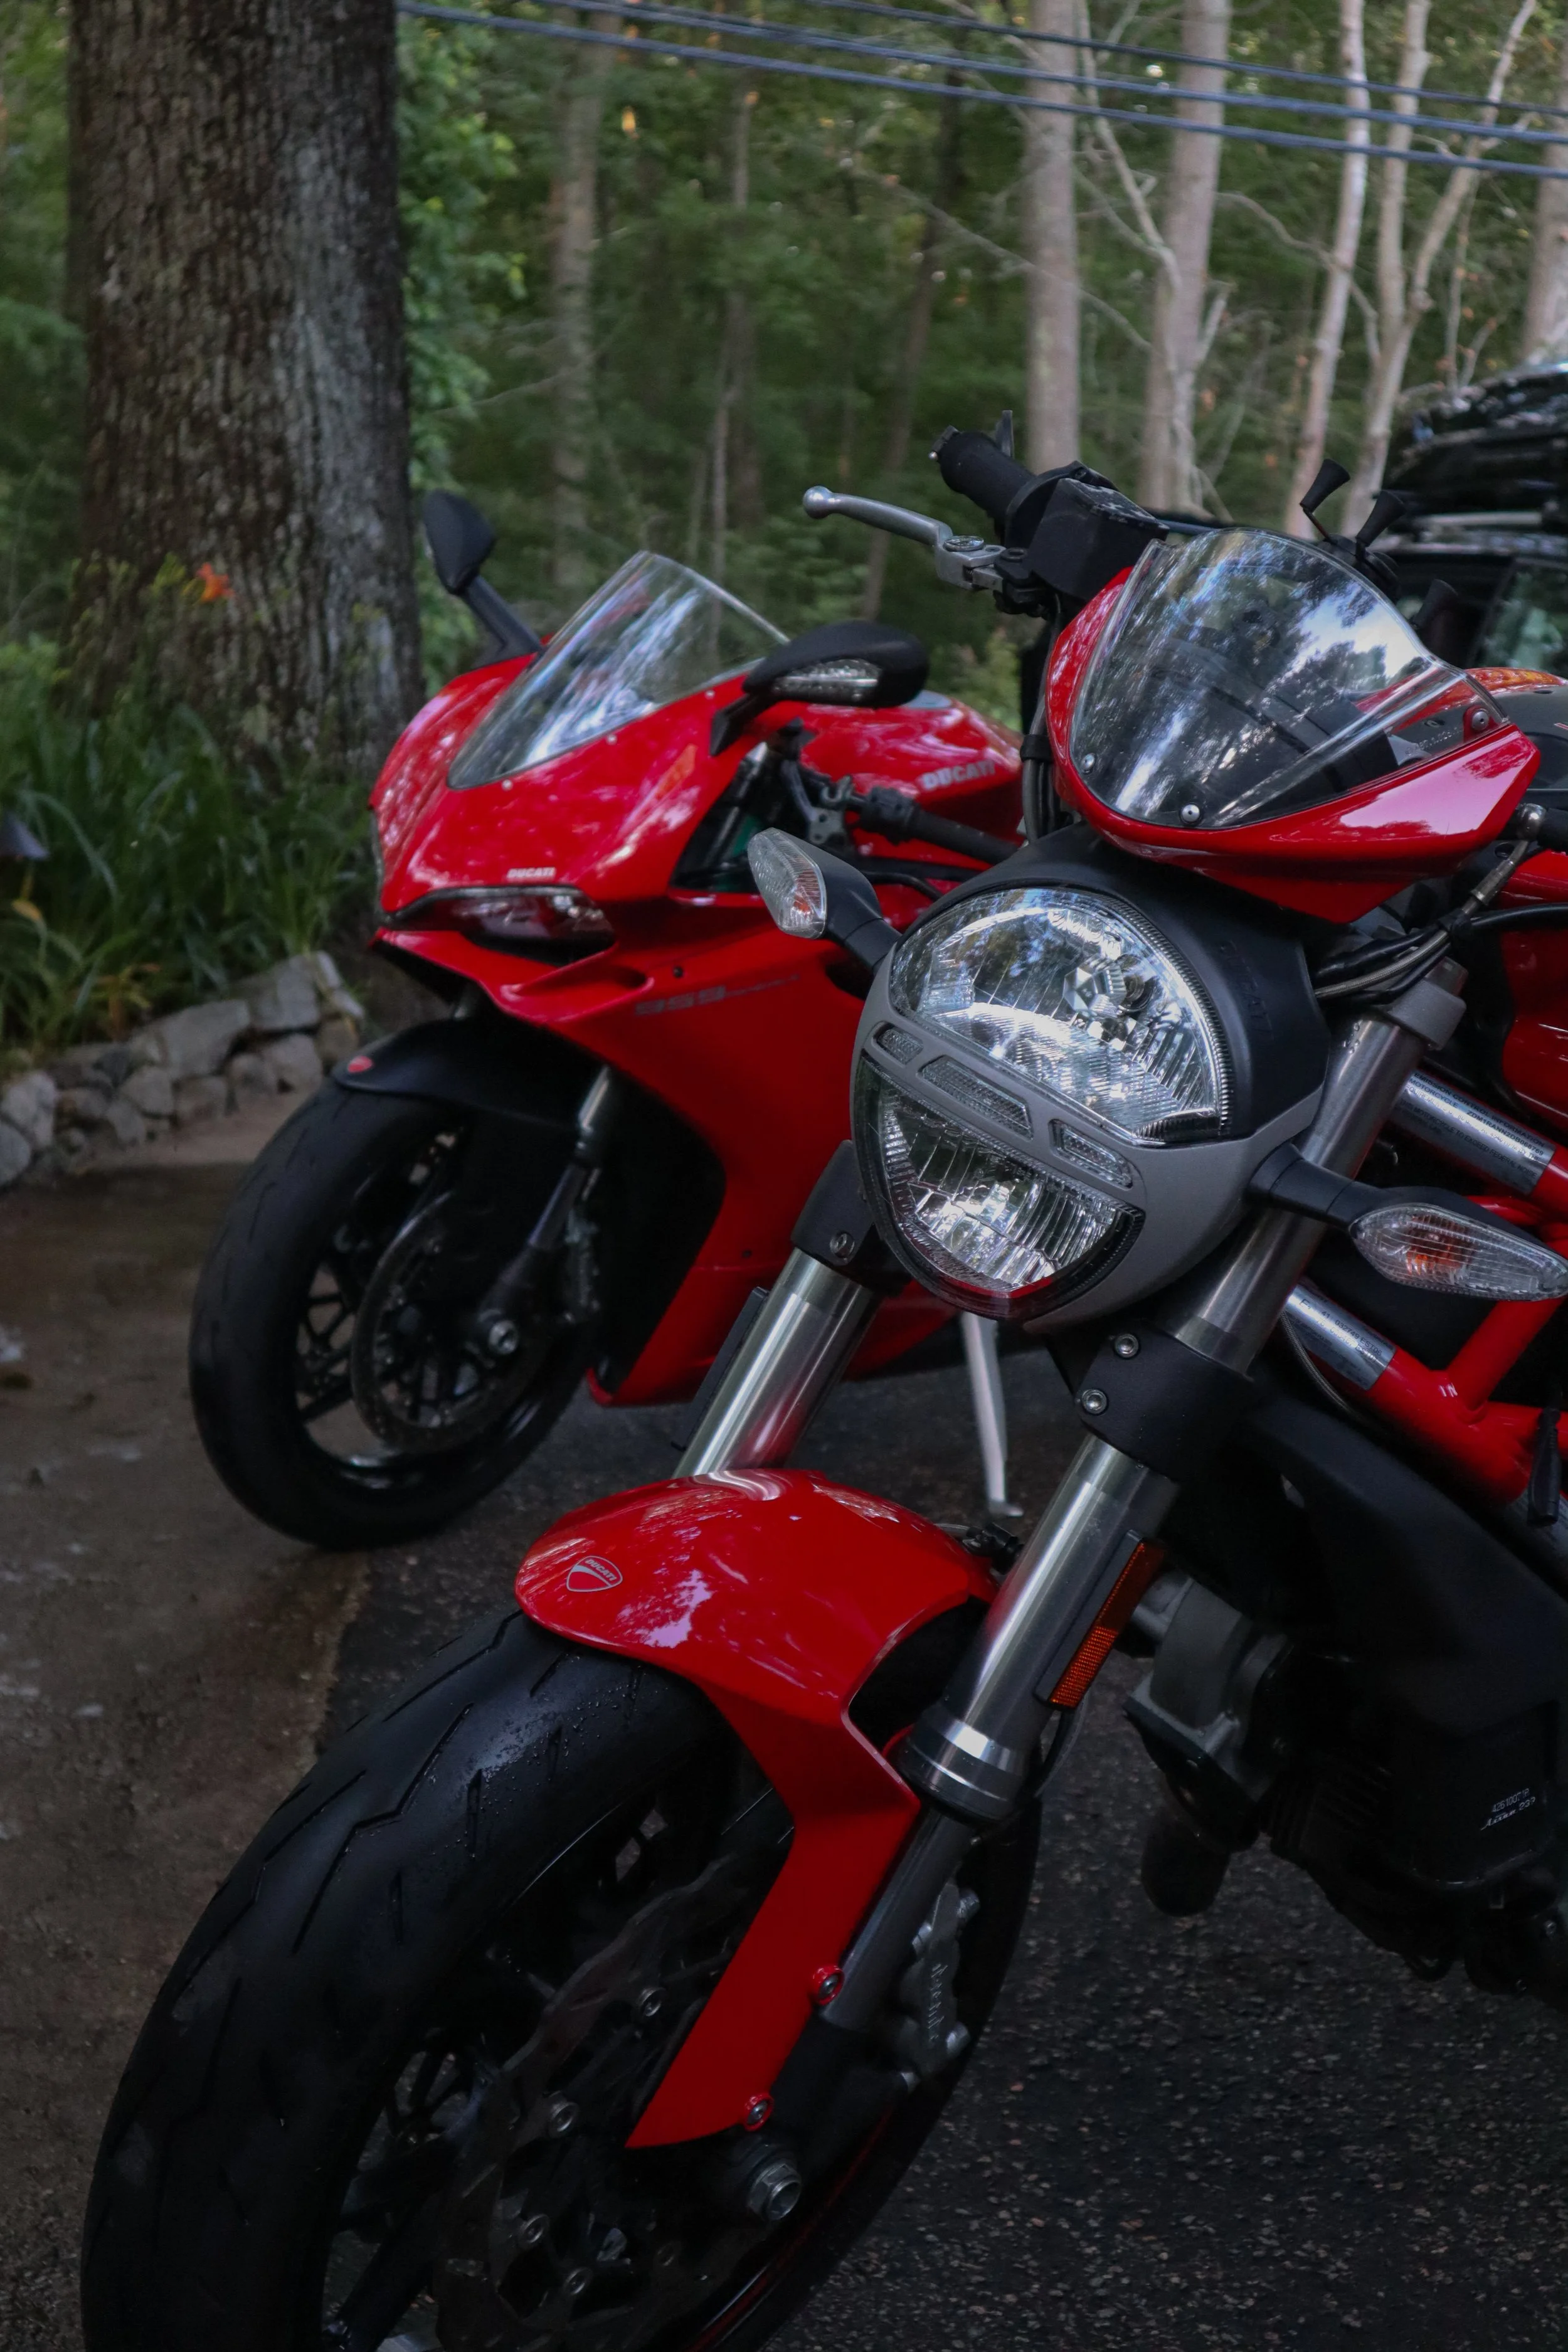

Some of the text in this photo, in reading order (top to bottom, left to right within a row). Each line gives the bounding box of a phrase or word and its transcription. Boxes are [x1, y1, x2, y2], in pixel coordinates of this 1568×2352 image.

[921, 760, 996, 792] DUCATI
[1408, 1078, 1459, 1109] MOTORCYCLE
[1414, 1072, 1452, 1096] EMISSION
[1451, 1093, 1491, 1118] CONTROL
[1491, 1115, 1545, 1148] INFORMATION
[585, 1559, 617, 1581] DUCATI
